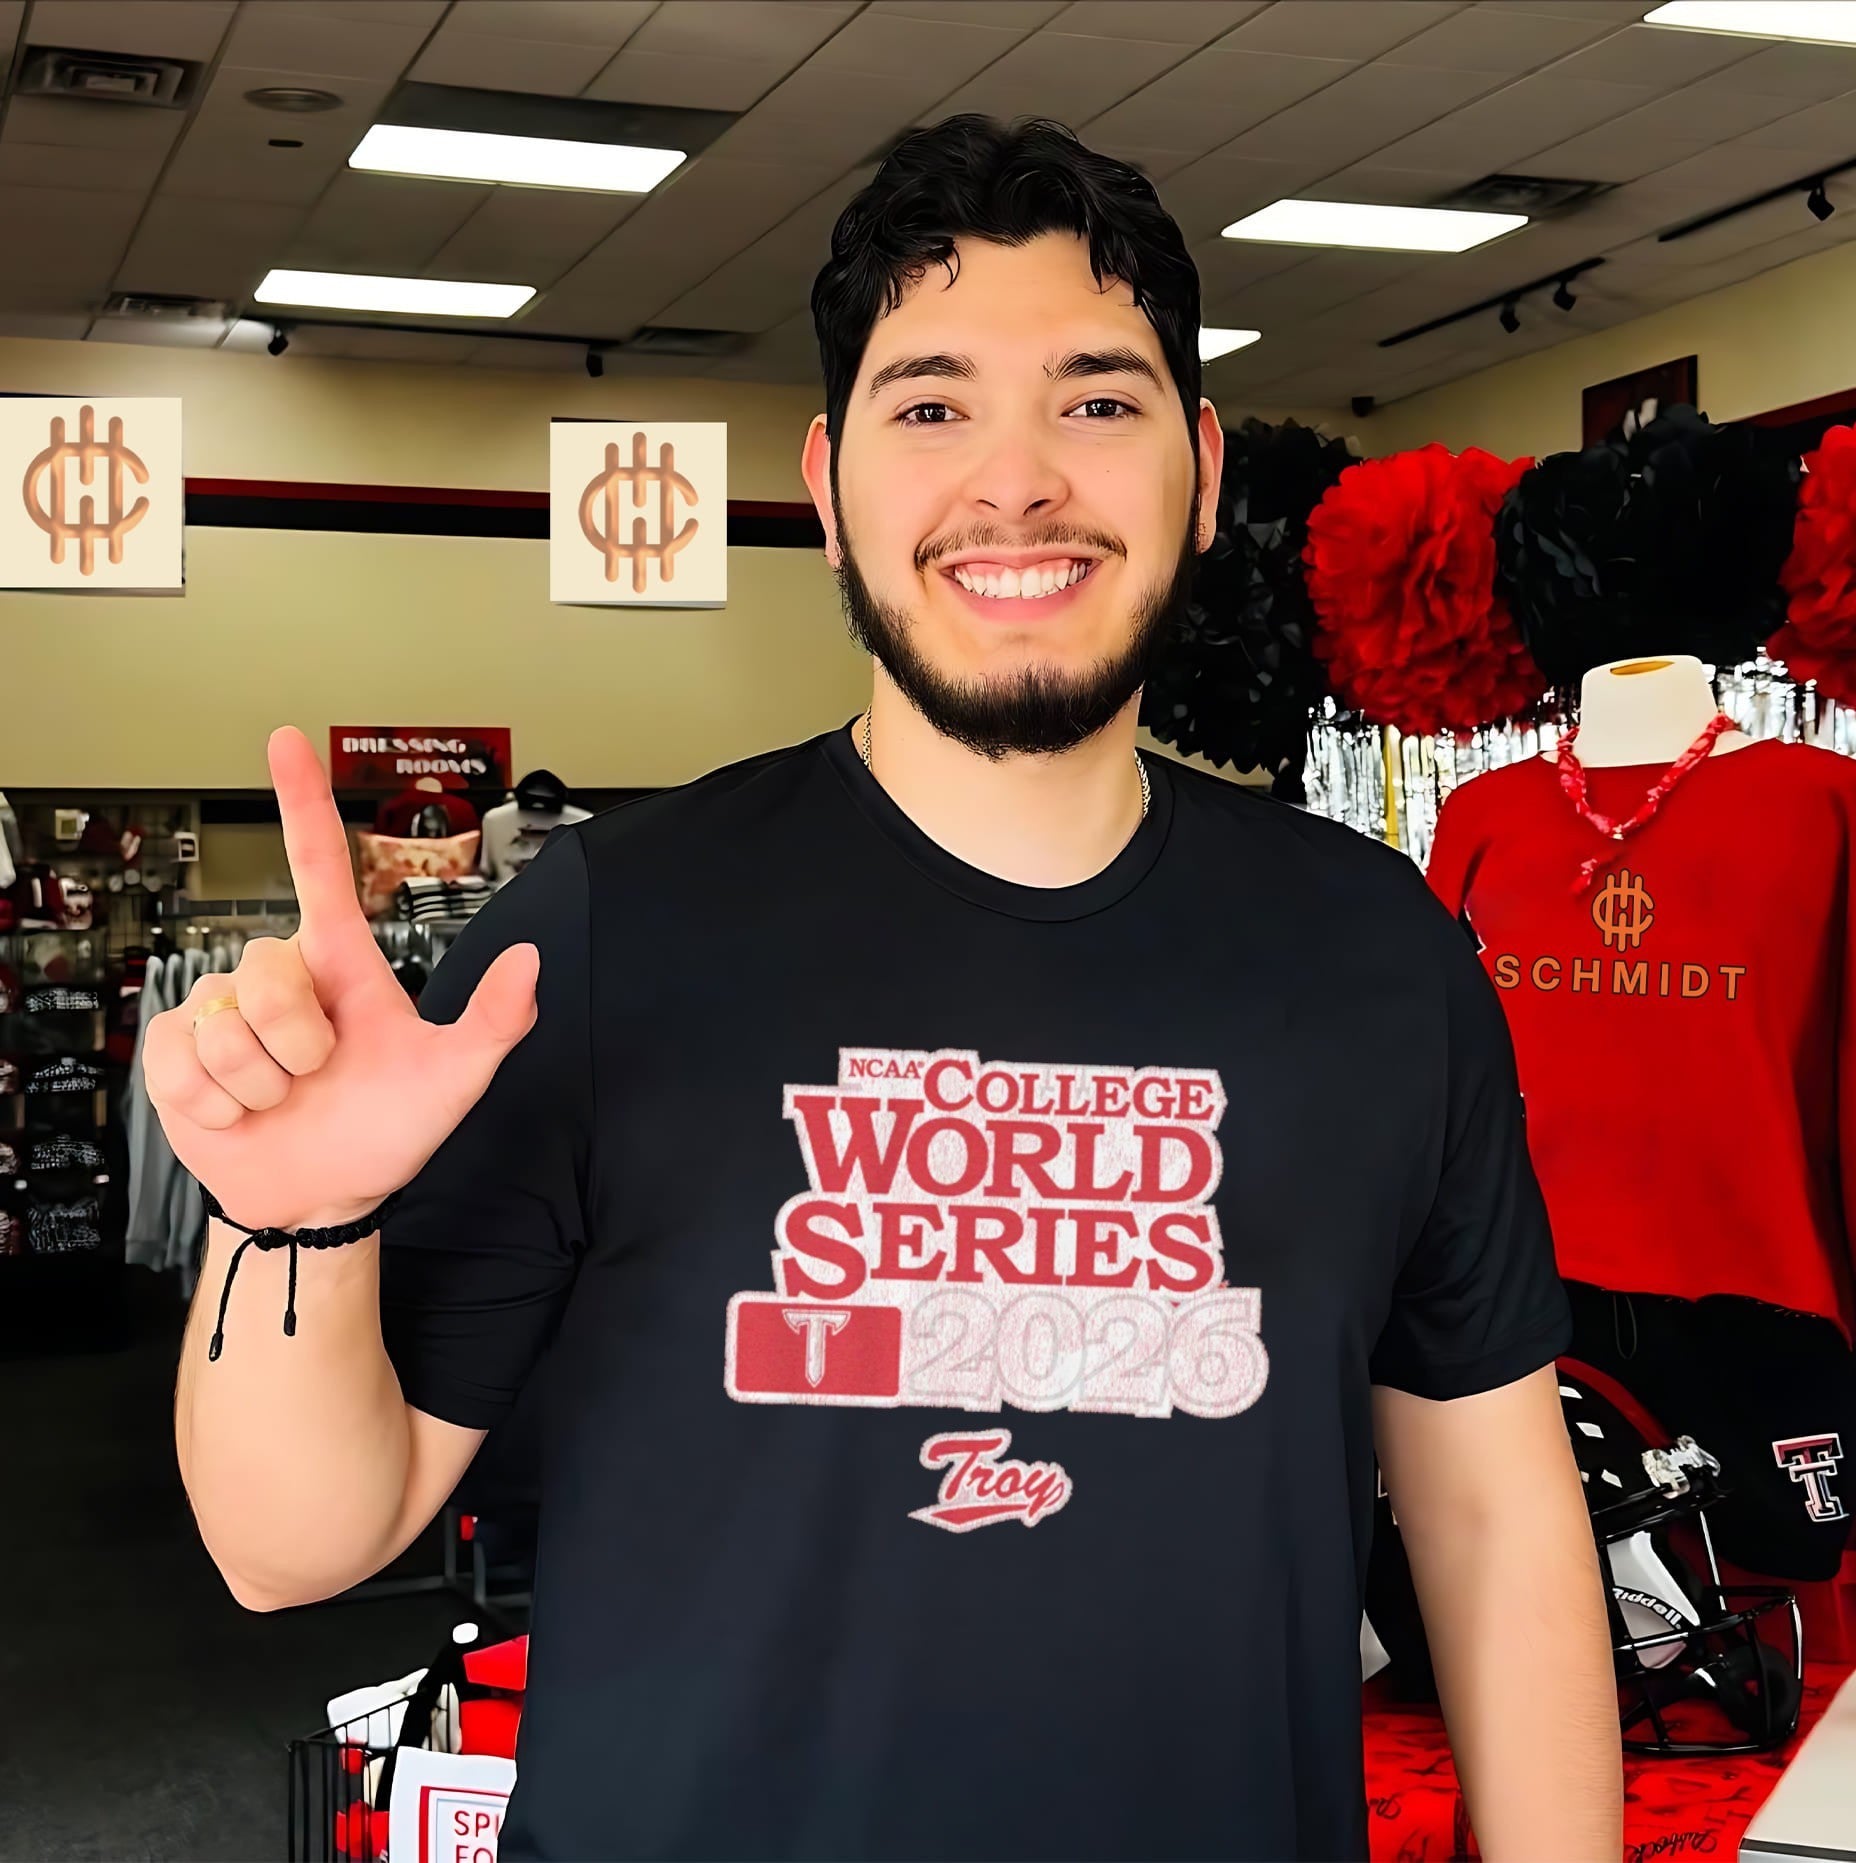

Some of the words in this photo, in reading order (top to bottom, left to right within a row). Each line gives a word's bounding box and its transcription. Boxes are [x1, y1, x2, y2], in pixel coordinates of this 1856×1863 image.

[1494, 954, 1747, 1000] SCHMIDT
[923, 1058, 1216, 1122] COLLEGE
[793, 1095, 1212, 1203] WORLD
[782, 1200, 1216, 1301] SERIES
[907, 1288, 1259, 1407] 2026
[926, 1436, 1064, 1518] Troy
